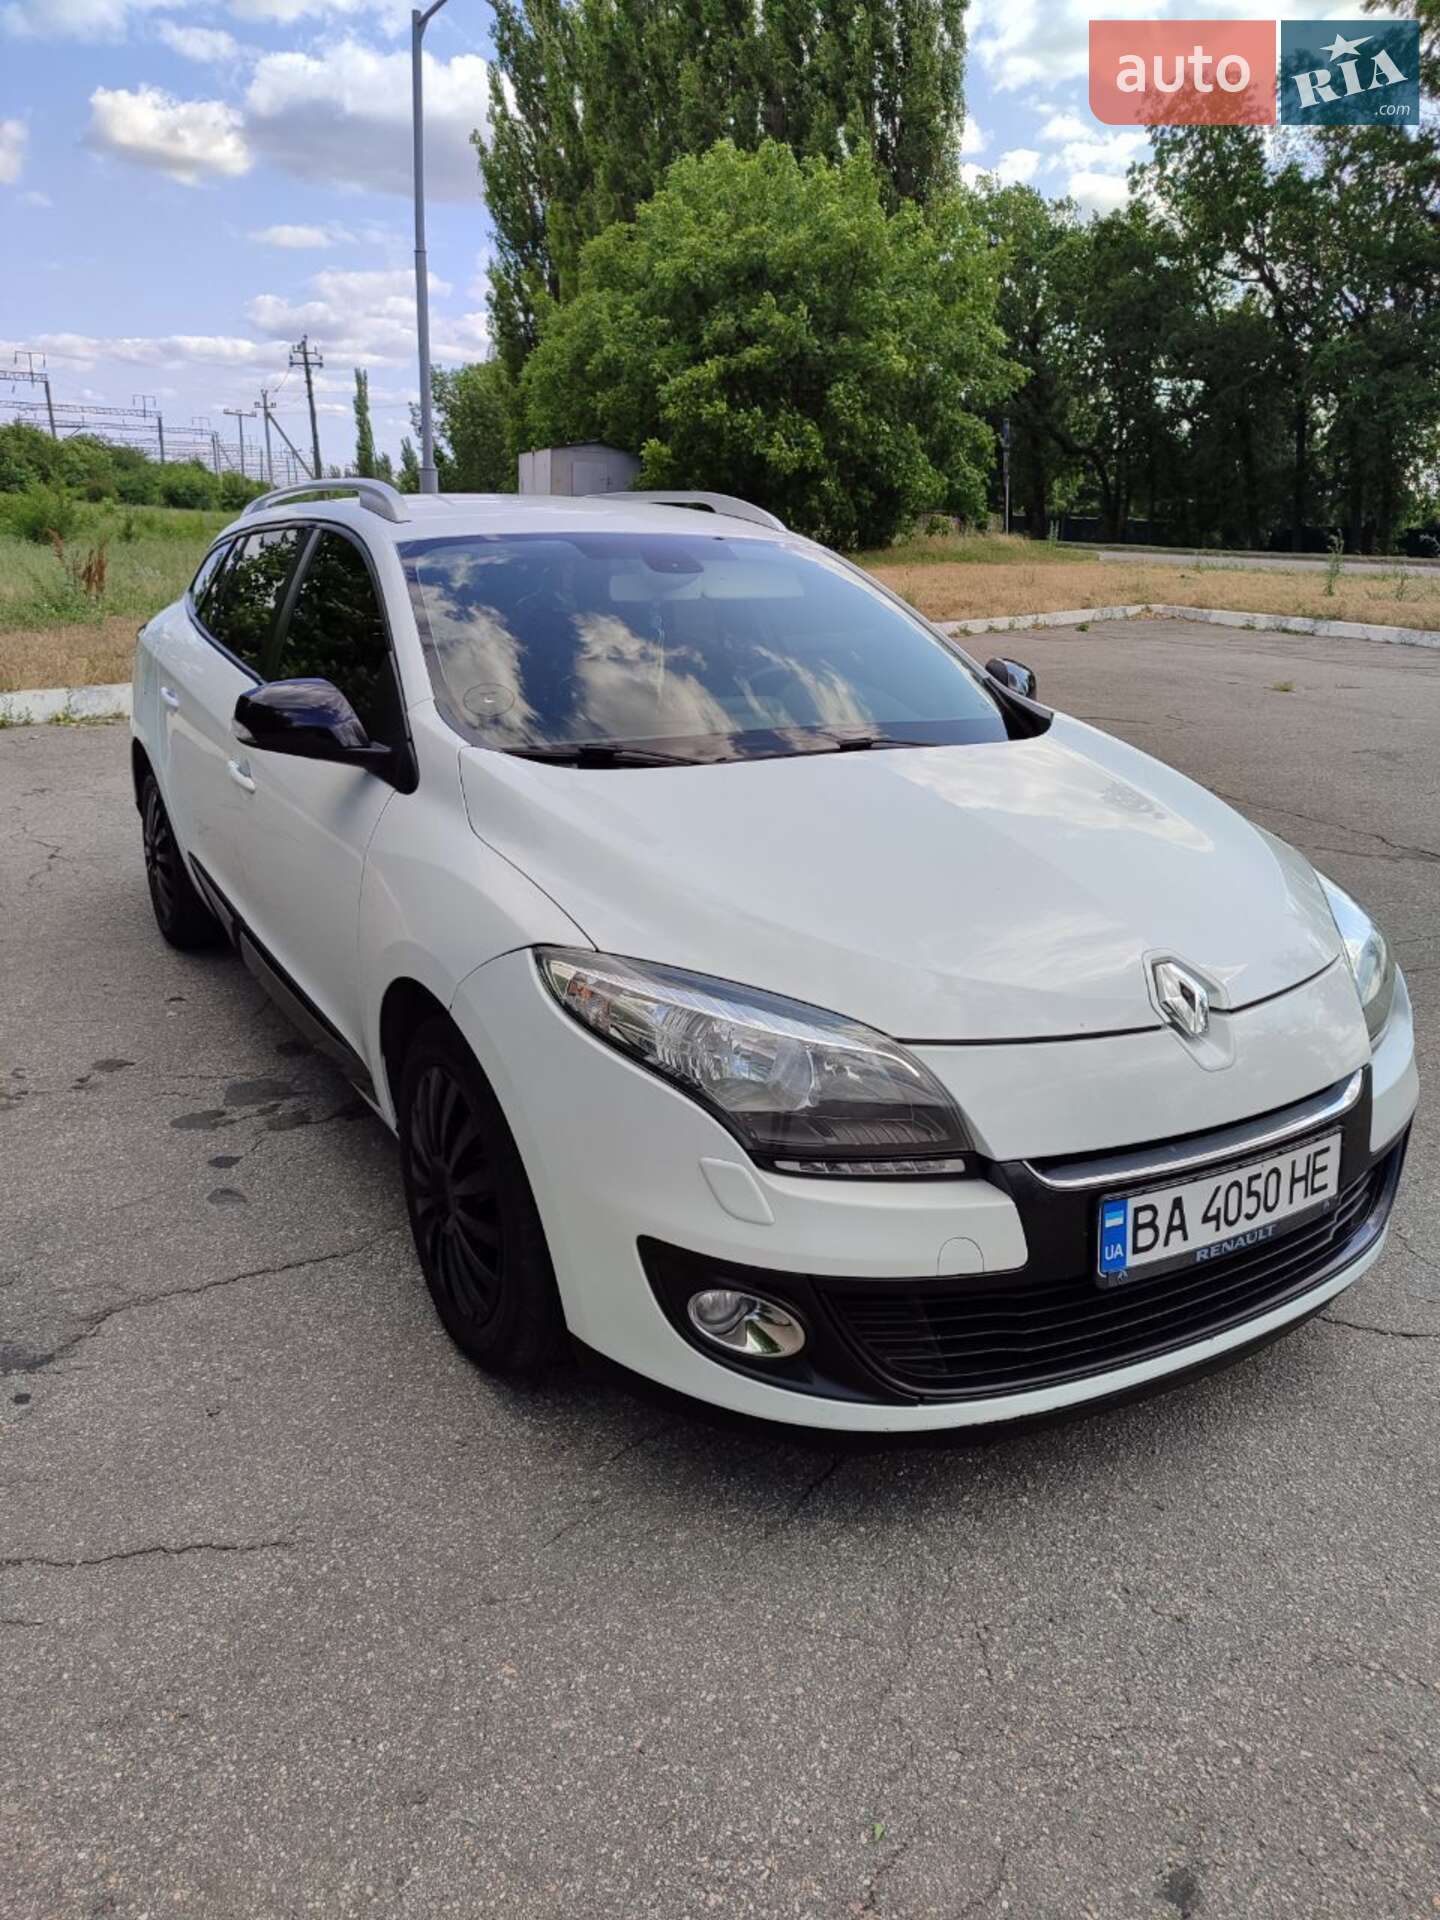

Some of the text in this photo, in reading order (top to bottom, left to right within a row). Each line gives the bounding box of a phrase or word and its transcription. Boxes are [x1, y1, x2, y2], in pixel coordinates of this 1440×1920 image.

[1132, 1146, 1331, 1256] BA 4050 HE
[1104, 1243, 1125, 1261] UA
[1195, 1223, 1278, 1263] RENAULT
